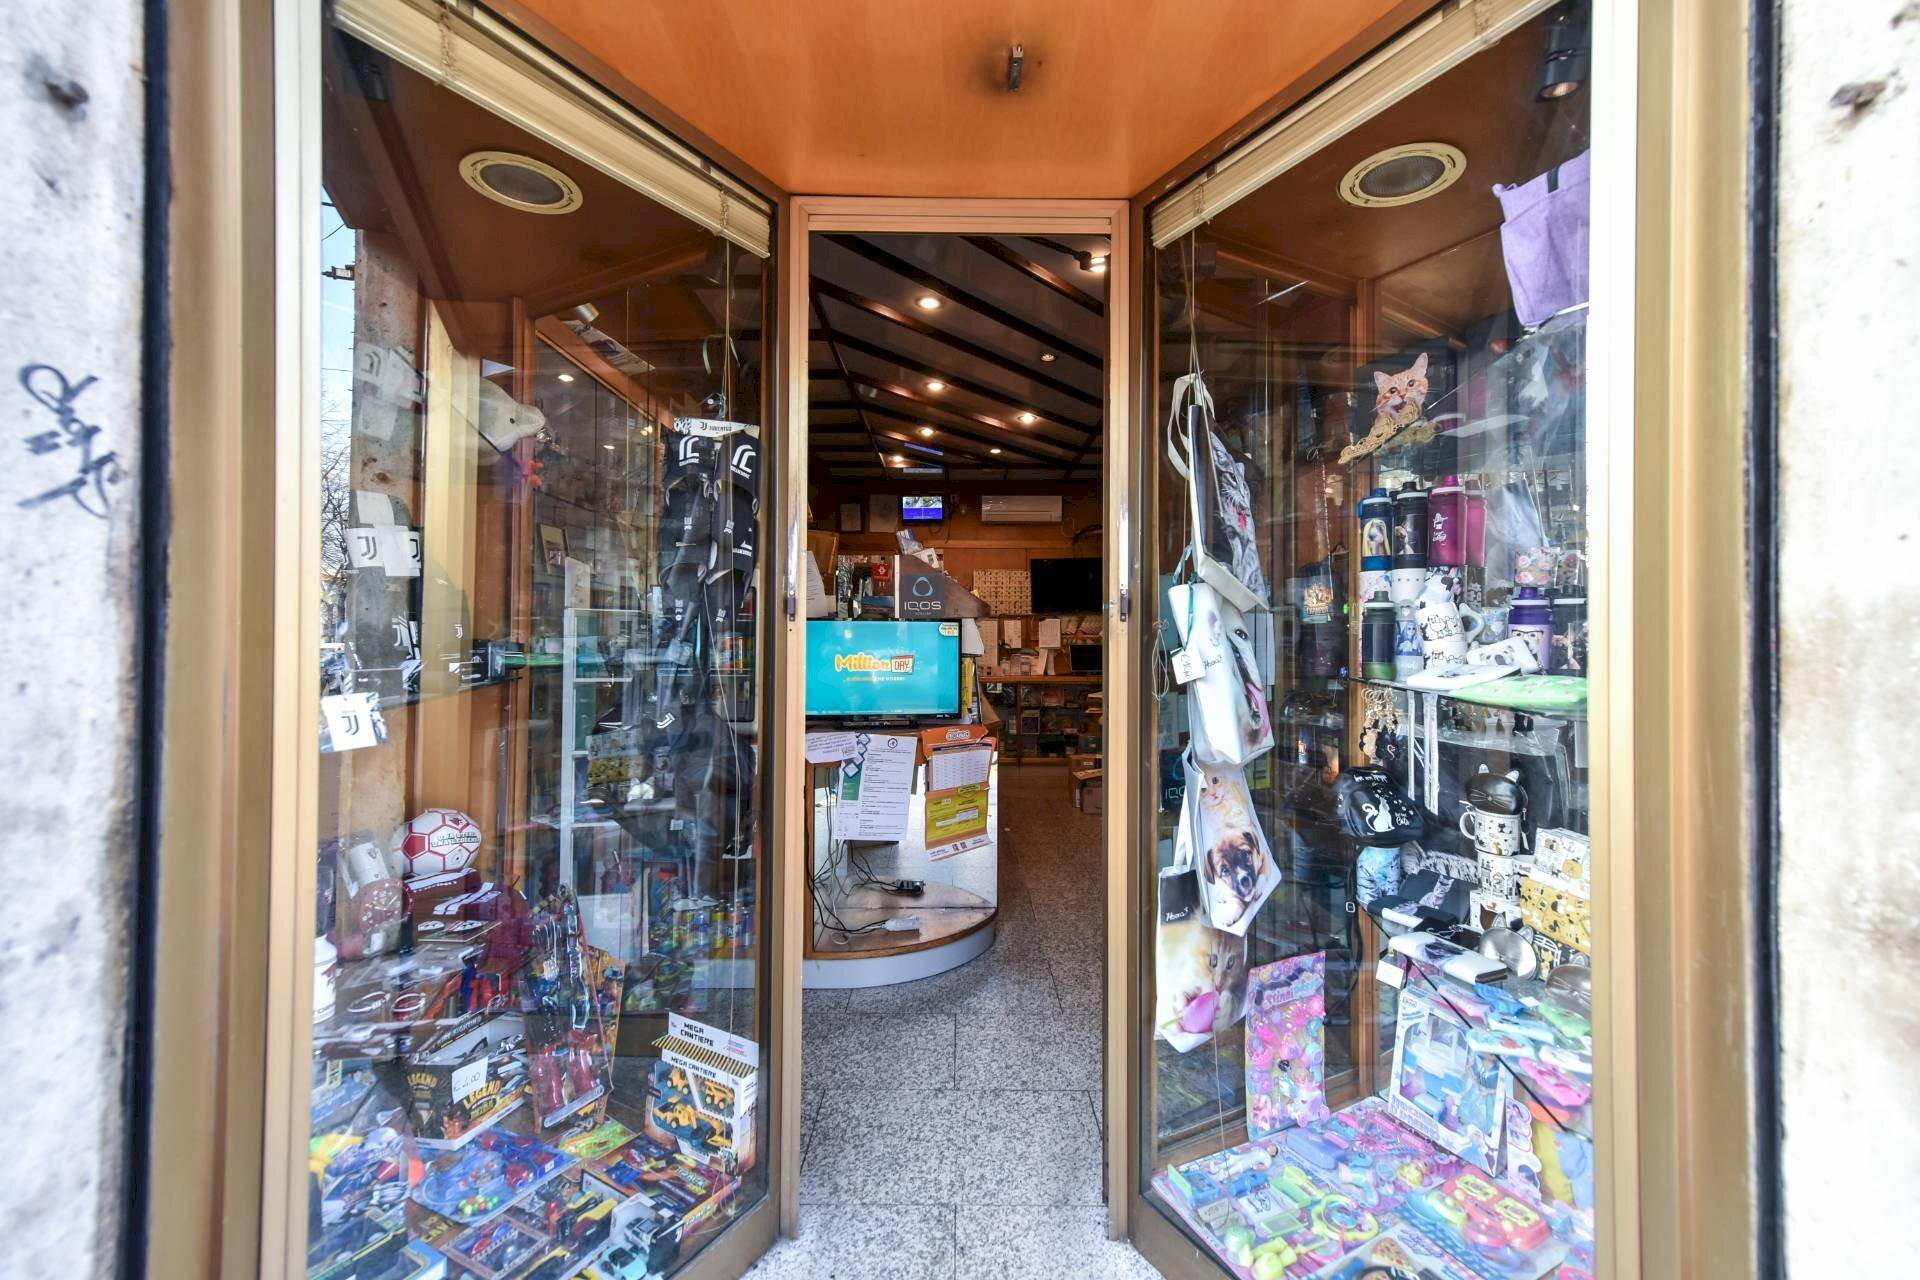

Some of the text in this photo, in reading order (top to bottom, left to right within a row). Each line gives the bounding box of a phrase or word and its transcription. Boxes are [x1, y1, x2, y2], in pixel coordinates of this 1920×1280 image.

[904, 601, 942, 612] IQOS
[835, 652, 910, 672] Million DAY
[1166, 786, 1185, 799] IQO
[683, 1022, 704, 1034] MEGA
[680, 1029, 714, 1047] CANTIERE
[671, 1056, 717, 1079] MEGA CANTIERE
[407, 1072, 438, 1089] LEGEND
[463, 1080, 501, 1110] LEGEND
